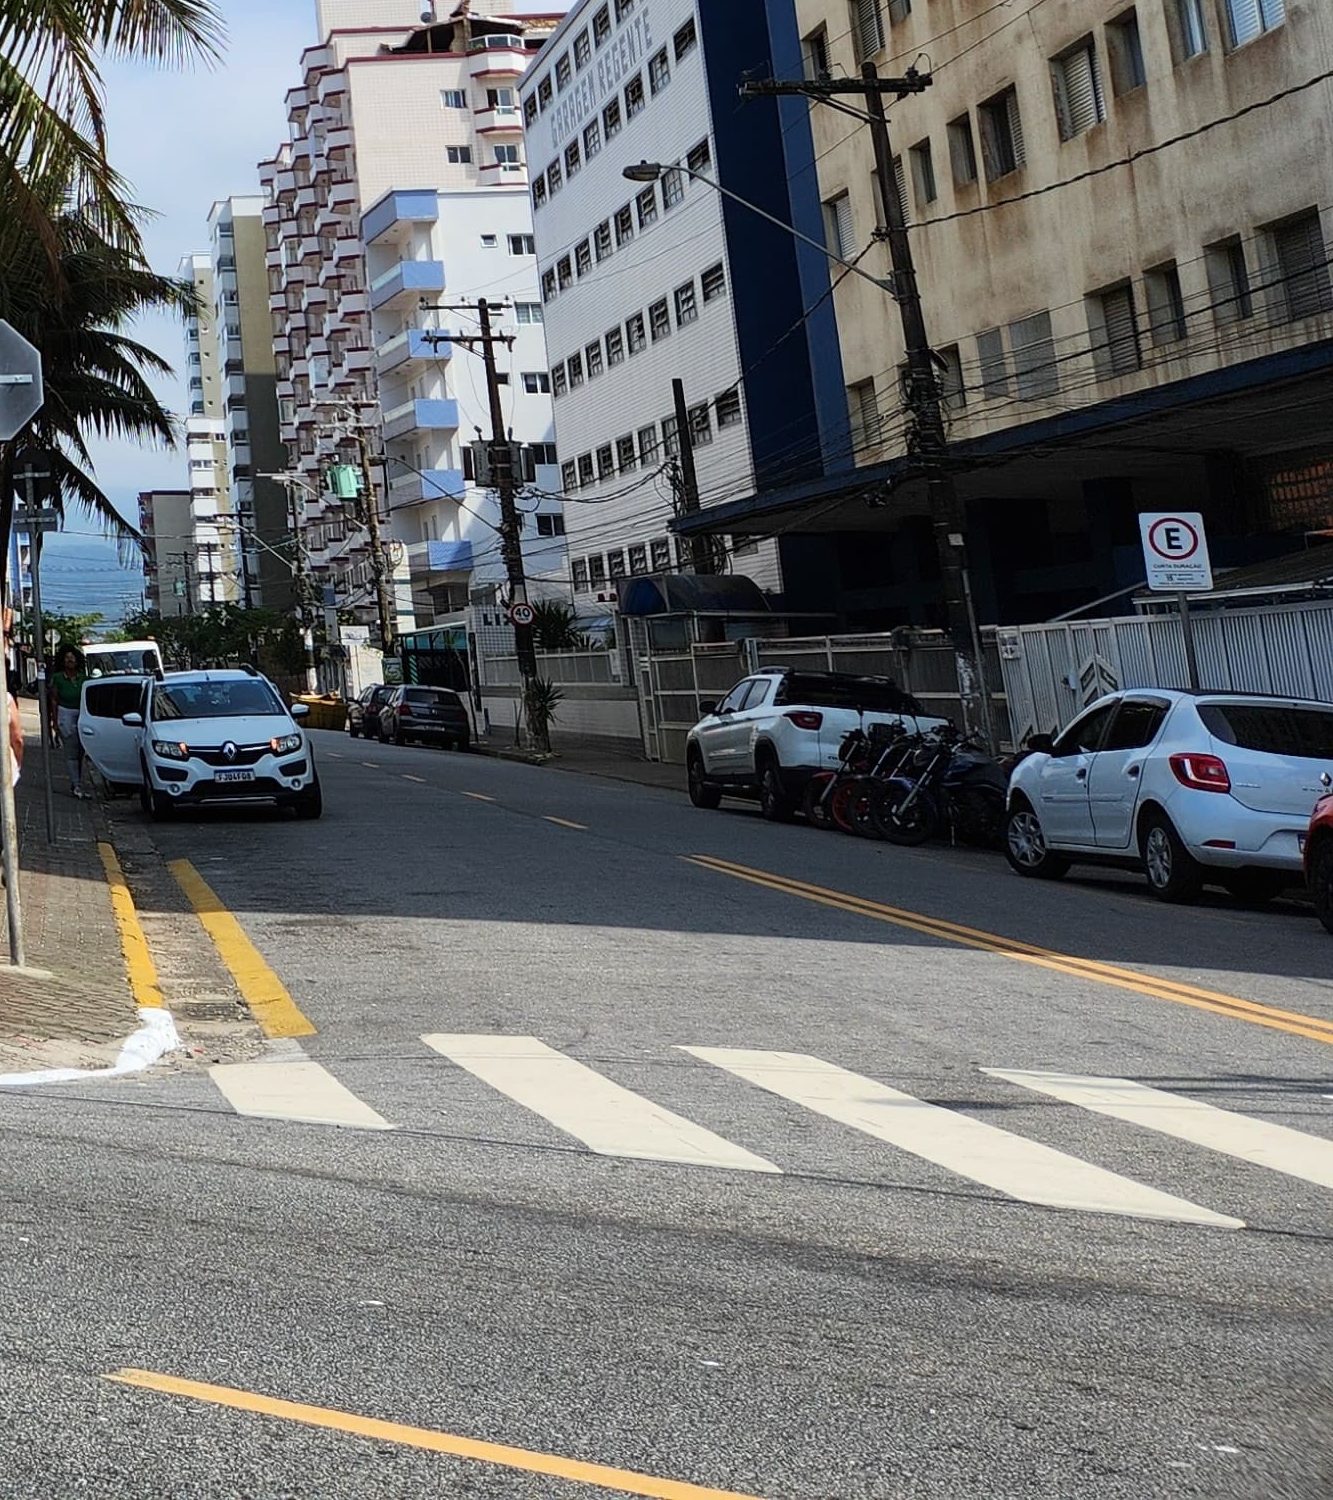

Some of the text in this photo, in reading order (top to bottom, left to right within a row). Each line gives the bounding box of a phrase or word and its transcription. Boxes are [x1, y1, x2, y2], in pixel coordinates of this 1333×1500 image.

[551, 7, 652, 149] GARAGEM REGENTE
[1164, 527, 1183, 550] E
[516, 607, 531, 618] 40
